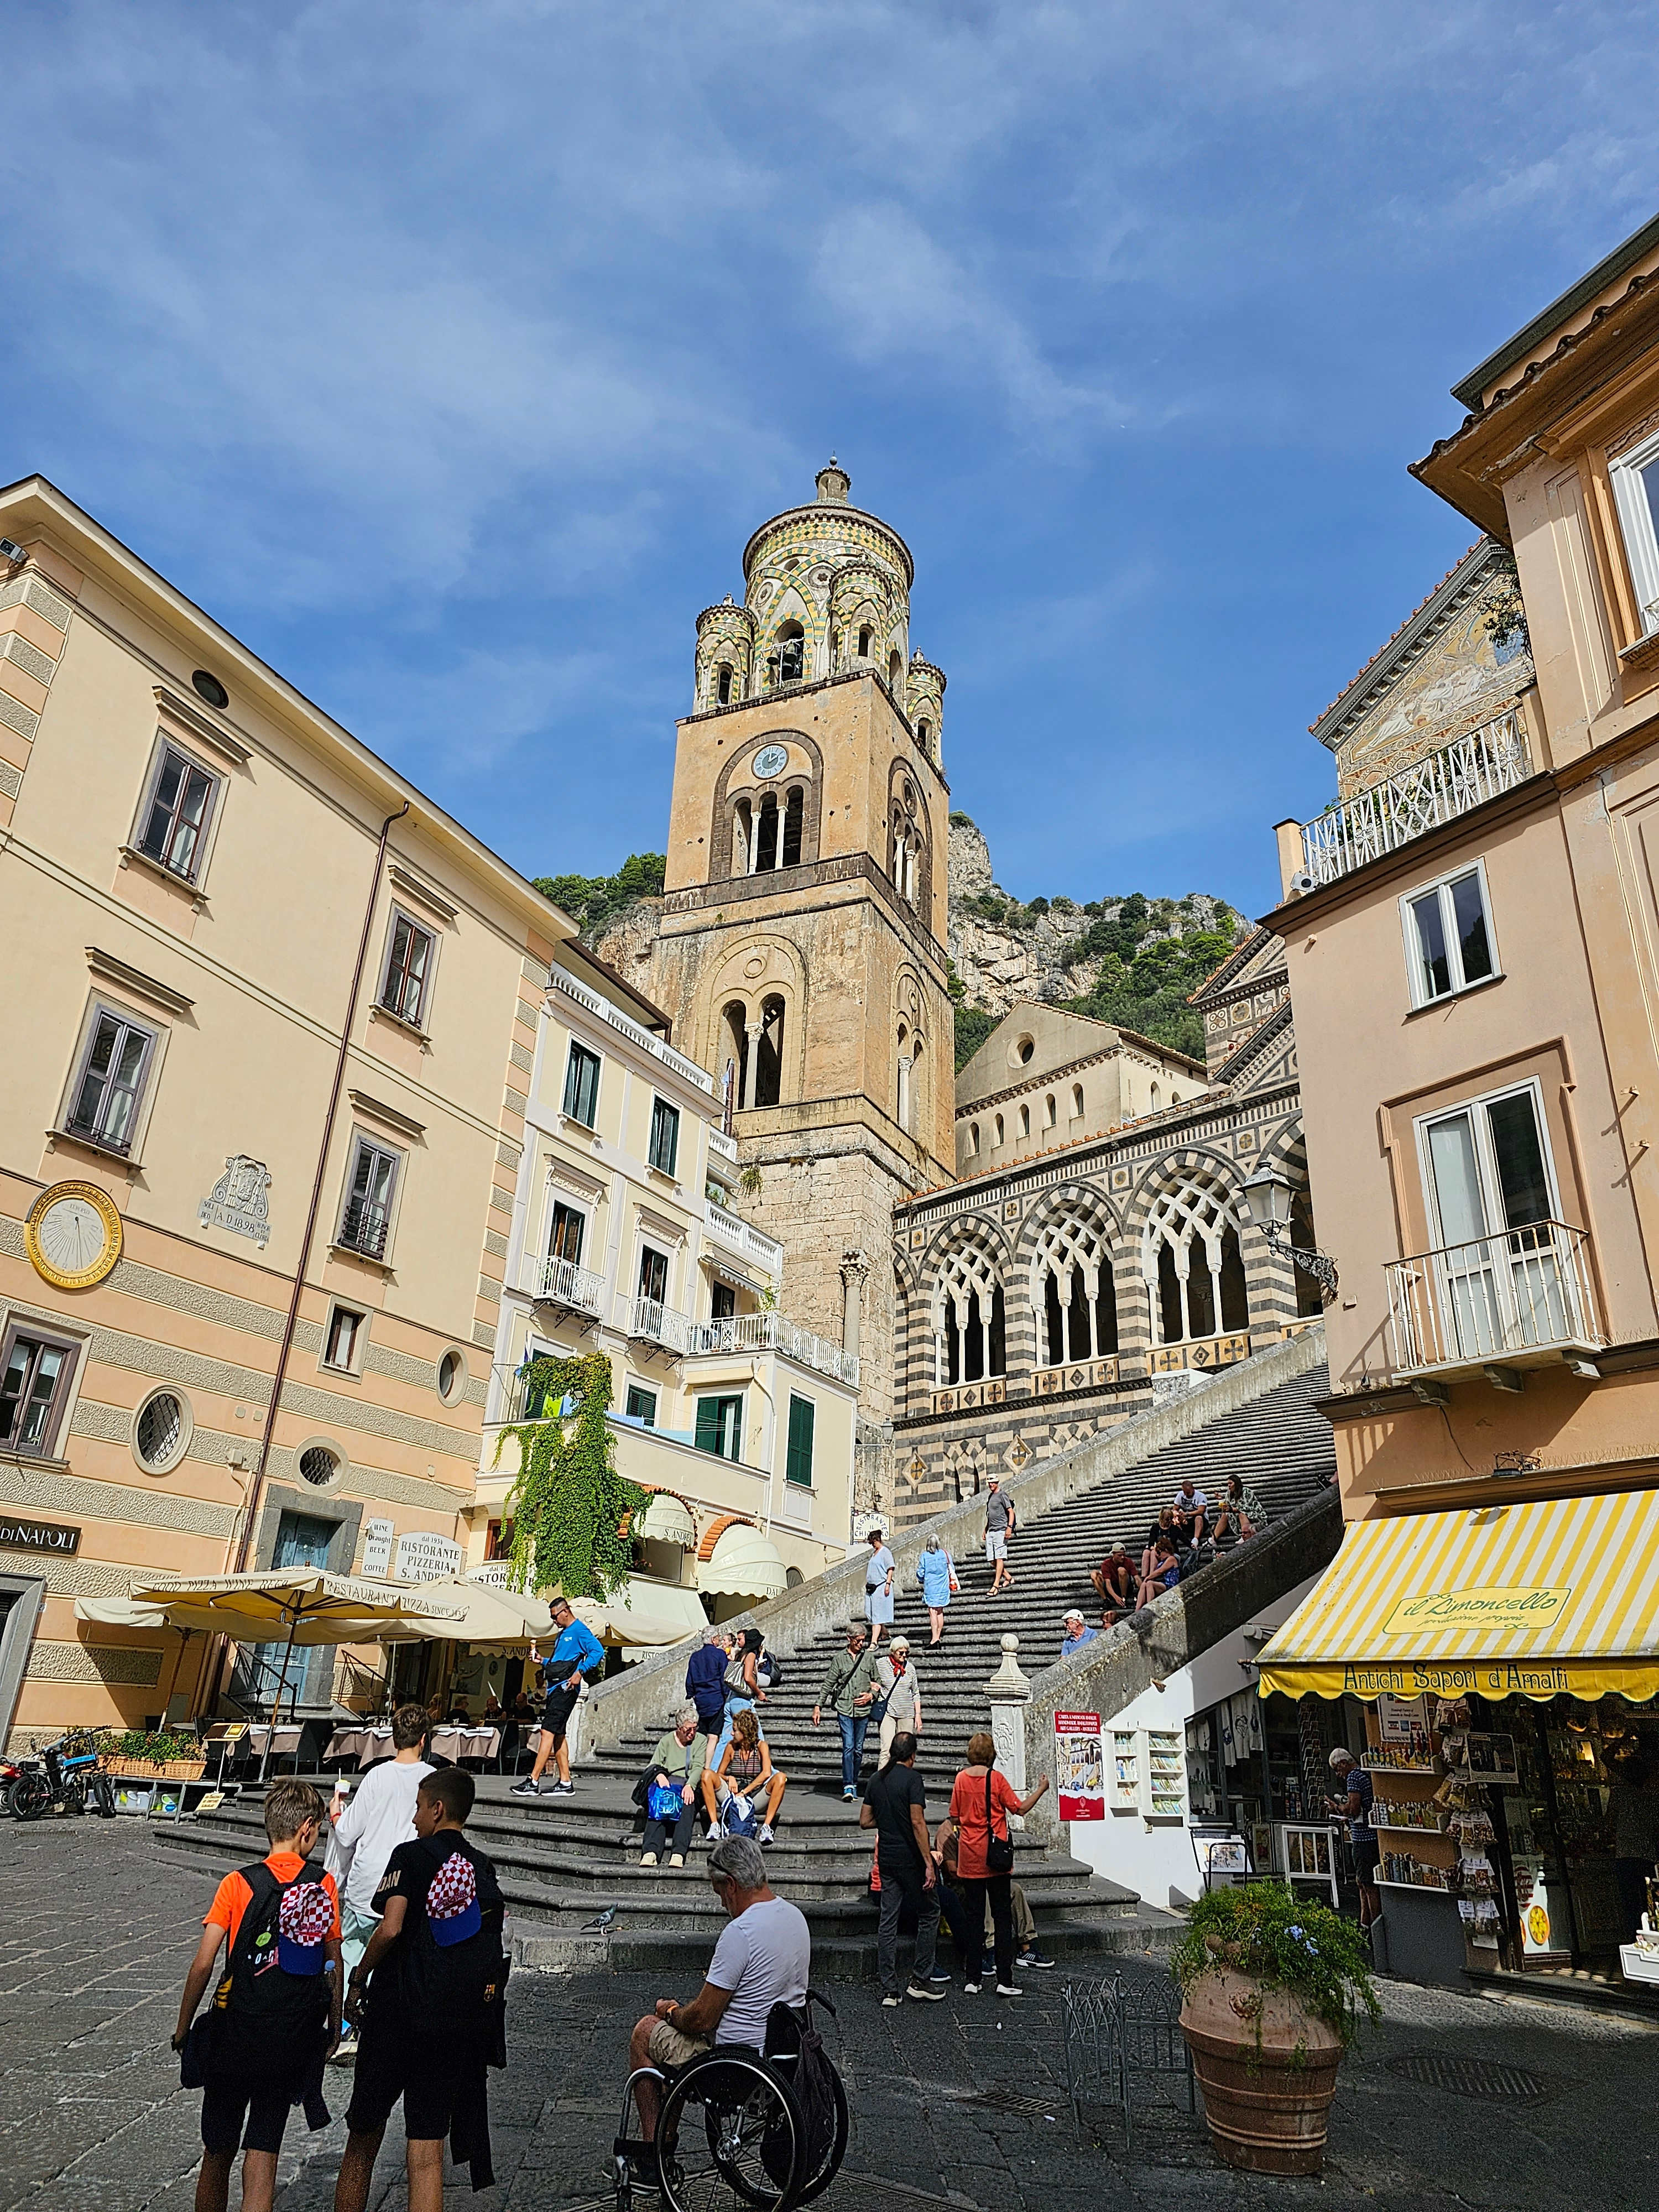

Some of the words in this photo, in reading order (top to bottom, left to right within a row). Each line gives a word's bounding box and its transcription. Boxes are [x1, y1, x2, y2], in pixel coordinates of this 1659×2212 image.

[204, 1201, 214, 1210] SOLI
[234, 1217, 255, 1233] 1898
[374, 1524, 389, 1532] WINE
[856, 1514, 888, 1530] RISTORANTE
[14, 1525, 76, 1549] NAPOLI
[368, 1534, 391, 1544] Draught
[664, 1528, 670, 1537] S.
[369, 1546, 386, 1554] BEER
[401, 1541, 460, 1560] RISTORANTE
[364, 1564, 386, 1573] COFFEE
[407, 1556, 450, 1572] PIZZERIA
[401, 1568, 410, 1578] S.
[414, 1571, 446, 1582] ANDR
[152, 1582, 181, 1592] FOOD
[187, 1580, 218, 1591] PIZZA
[225, 1579, 253, 1590] WINE
[431, 1605, 450, 1616] SINCE
[1404, 1599, 1428, 1616] il
[1425, 1592, 1558, 1615] Limoncello
[502, 1646, 509, 1655] S.
[1343, 1663, 1404, 1690] Antichi
[1412, 1662, 1478, 1692] Sapori
[1489, 1663, 1569, 1689] d'Amalfi
